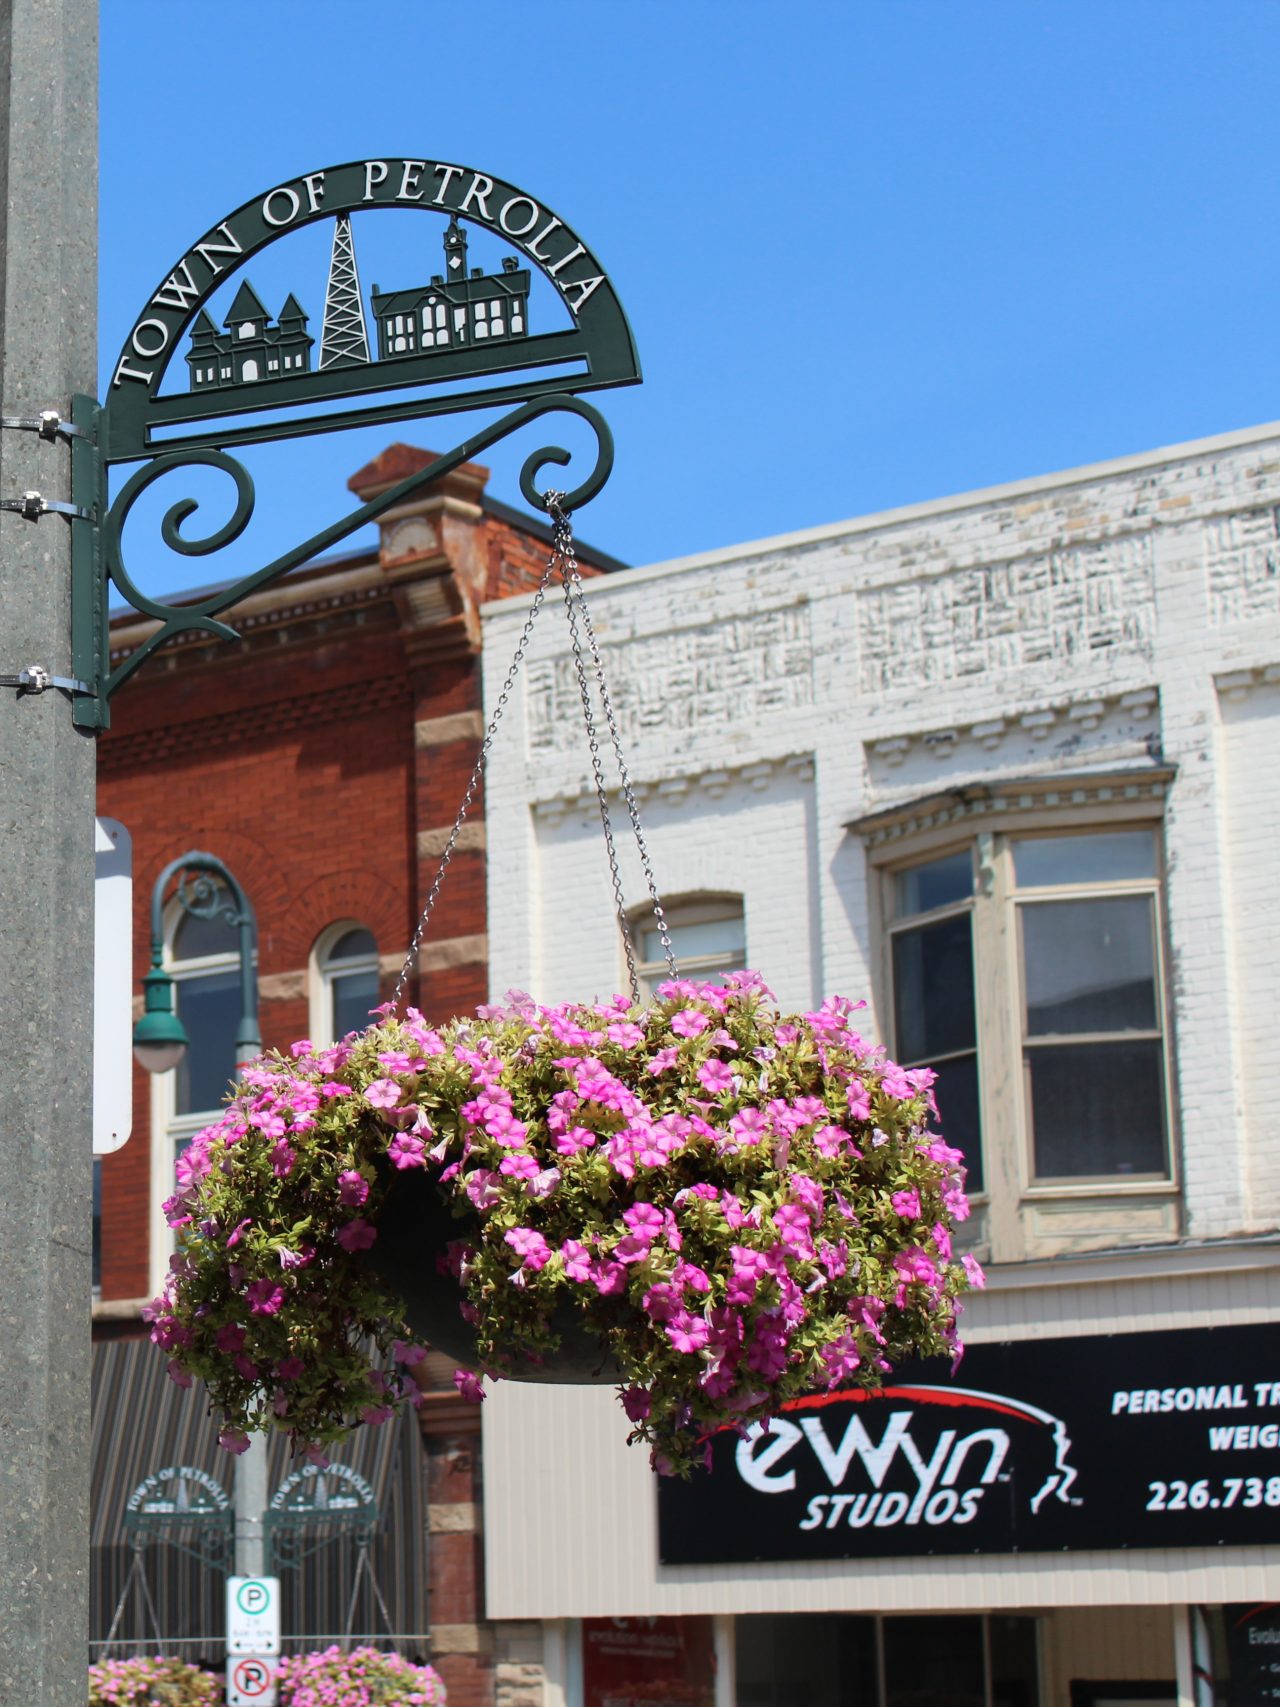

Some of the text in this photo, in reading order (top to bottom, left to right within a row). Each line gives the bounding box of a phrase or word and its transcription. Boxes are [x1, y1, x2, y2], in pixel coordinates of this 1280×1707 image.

[114, 160, 607, 389] TOWN OF PETROLIA
[1111, 1384, 1248, 1415] PERSONAL
[1209, 1424, 1280, 1451] WEIG
[799, 1488, 985, 1529] STUDIOS
